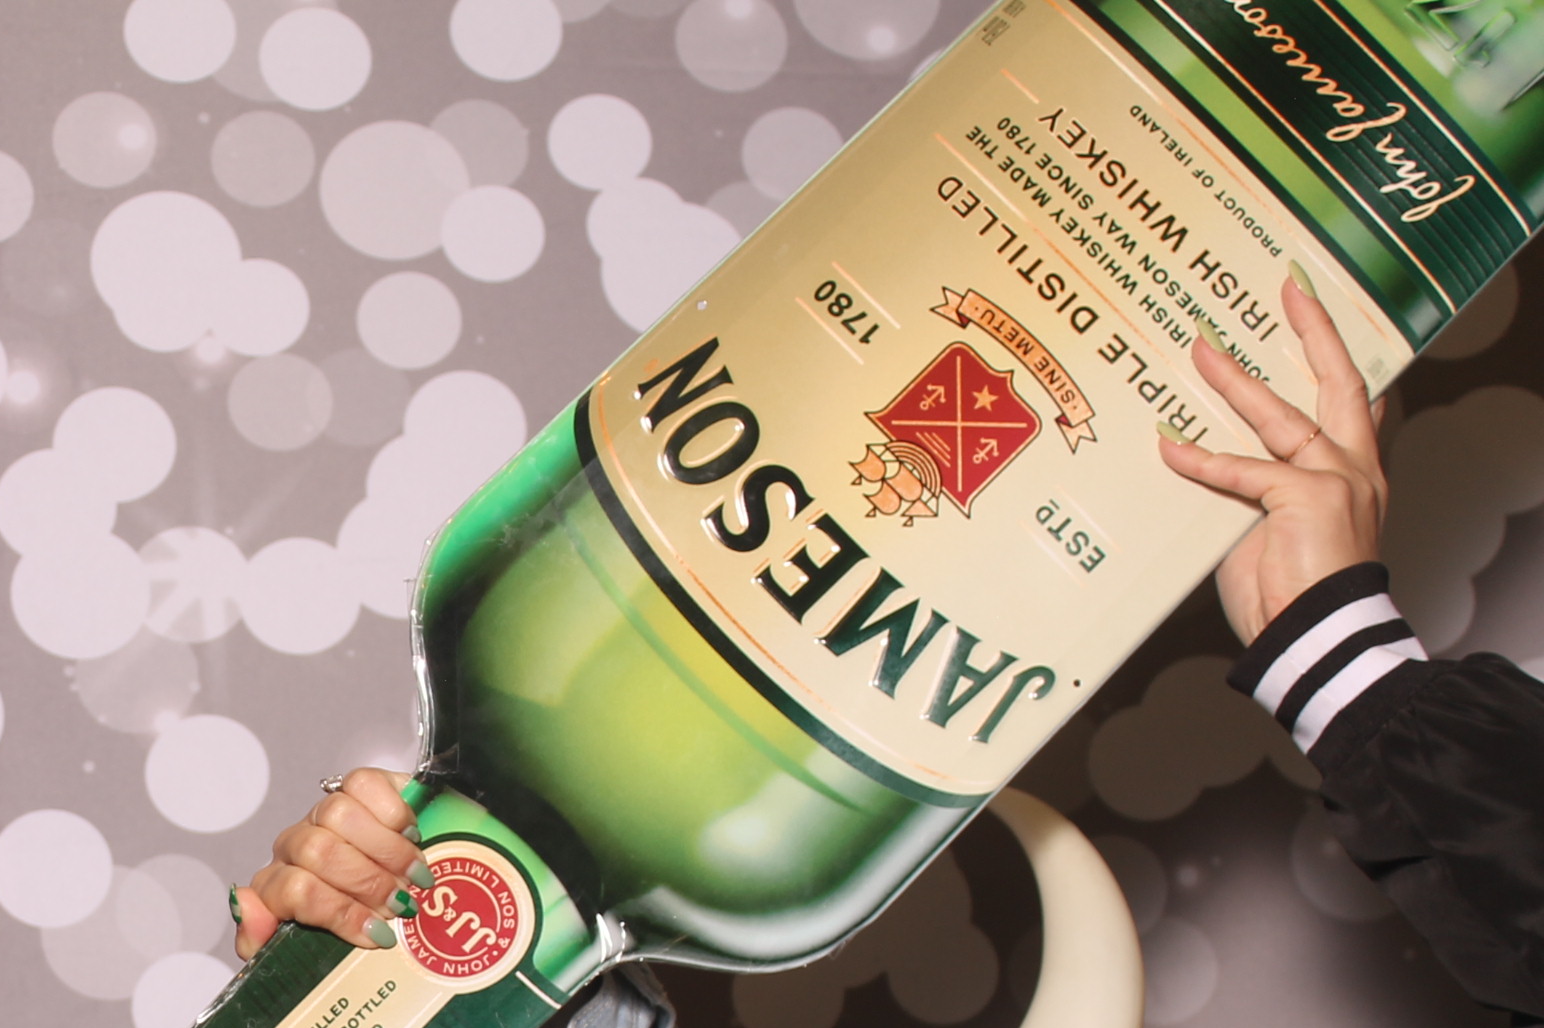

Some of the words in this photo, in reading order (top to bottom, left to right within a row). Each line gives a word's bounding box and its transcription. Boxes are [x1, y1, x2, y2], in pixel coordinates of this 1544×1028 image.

[965, 126, 1000, 159] THE
[996, 116, 1037, 156] 1780
[1129, 105, 1193, 167] IRELAND
[998, 156, 1053, 208] MADE
[1034, 153, 1095, 210] SINCE
[1037, 108, 1189, 253] WHISKEY
[1191, 168, 1215, 188] OF
[1376, 133, 1476, 222] John
[1049, 208, 1139, 296] WHISKEY
[1093, 212, 1138, 255] WAY
[1213, 190, 1283, 258] PRODUCT
[937, 176, 1100, 335] DISTILLED
[814, 280, 880, 344] 1780
[1138, 254, 1229, 338] AMESON
[1138, 294, 1193, 349] IRISH
[1188, 249, 1280, 343] IRISH
[979, 308, 1035, 356] METU
[1034, 355, 1075, 405] SINE
[634, 336, 1057, 744] JAMESON
[1036, 498, 1106, 573] ESTD
[430, 861, 500, 888] LIMITED
[498, 891, 516, 929] SON
[443, 954, 490, 974] JOHN
[497, 937, 511, 948] &
